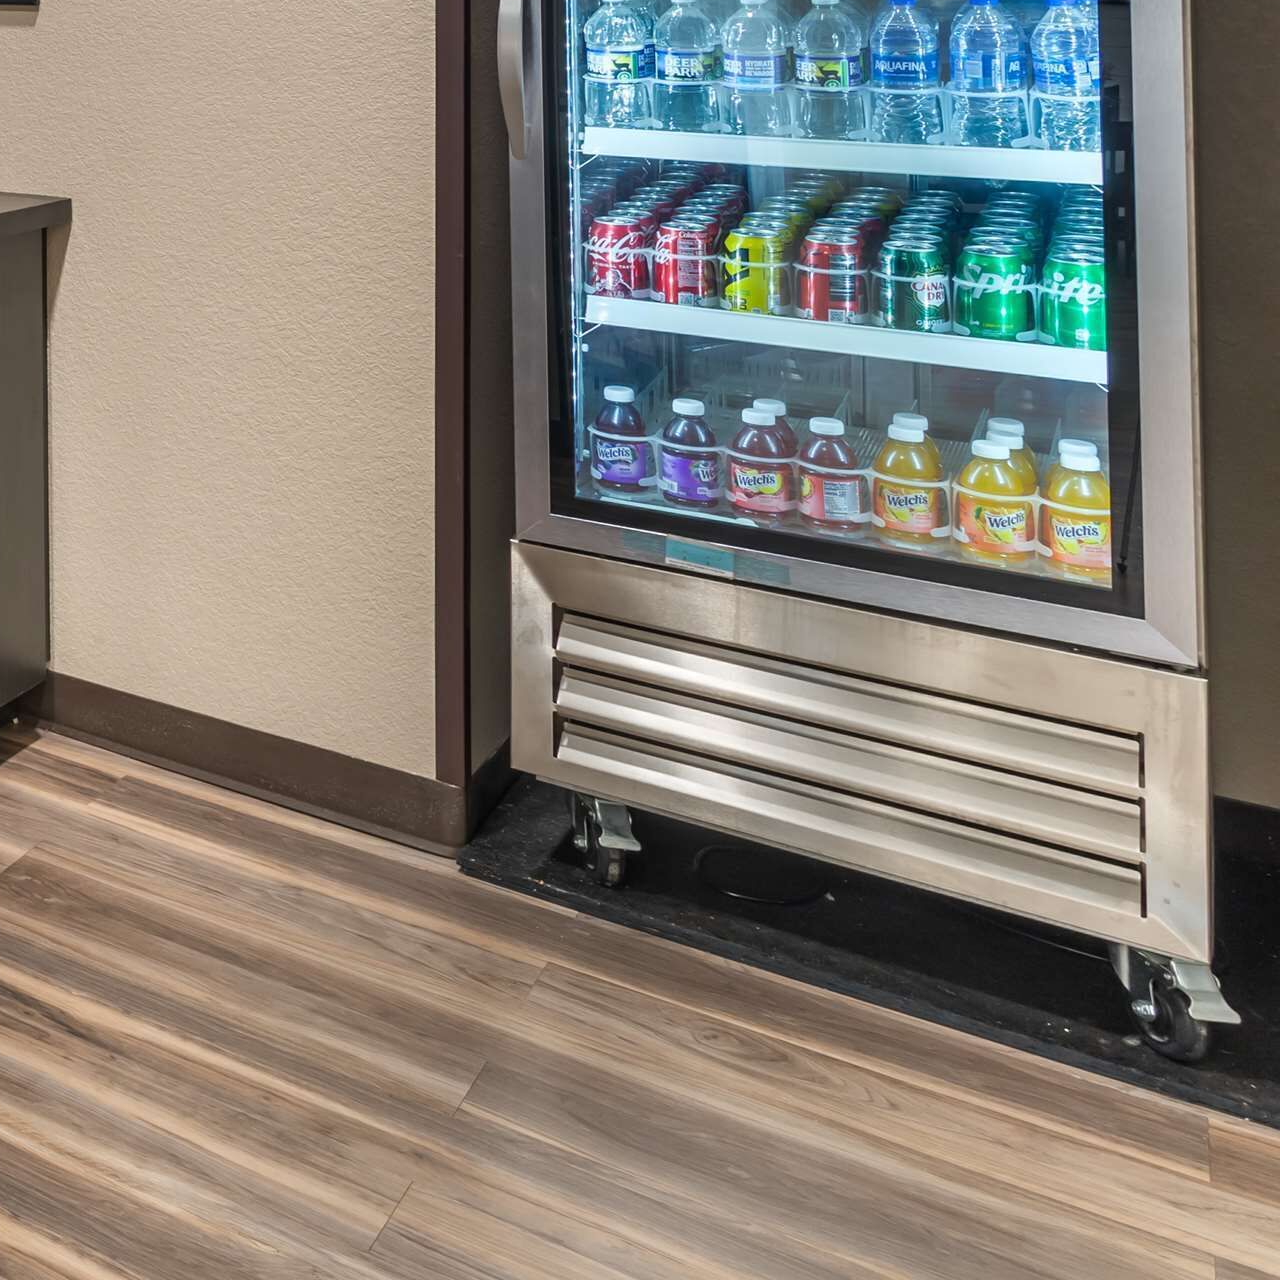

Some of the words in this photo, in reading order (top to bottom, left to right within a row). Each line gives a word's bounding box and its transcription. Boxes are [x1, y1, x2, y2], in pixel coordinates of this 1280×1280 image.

[666, 57, 698, 68] DEER
[796, 61, 817, 72] EER
[875, 60, 927, 72] AQUAFINA
[665, 67, 701, 78] PARK
[796, 71, 818, 82] ARK
[598, 446, 631, 459] Welch's
[738, 473, 776, 487] Welch's
[887, 494, 928, 508] Welch's
[987, 511, 1025, 529] Welch's
[1055, 524, 1100, 538] Welch's
